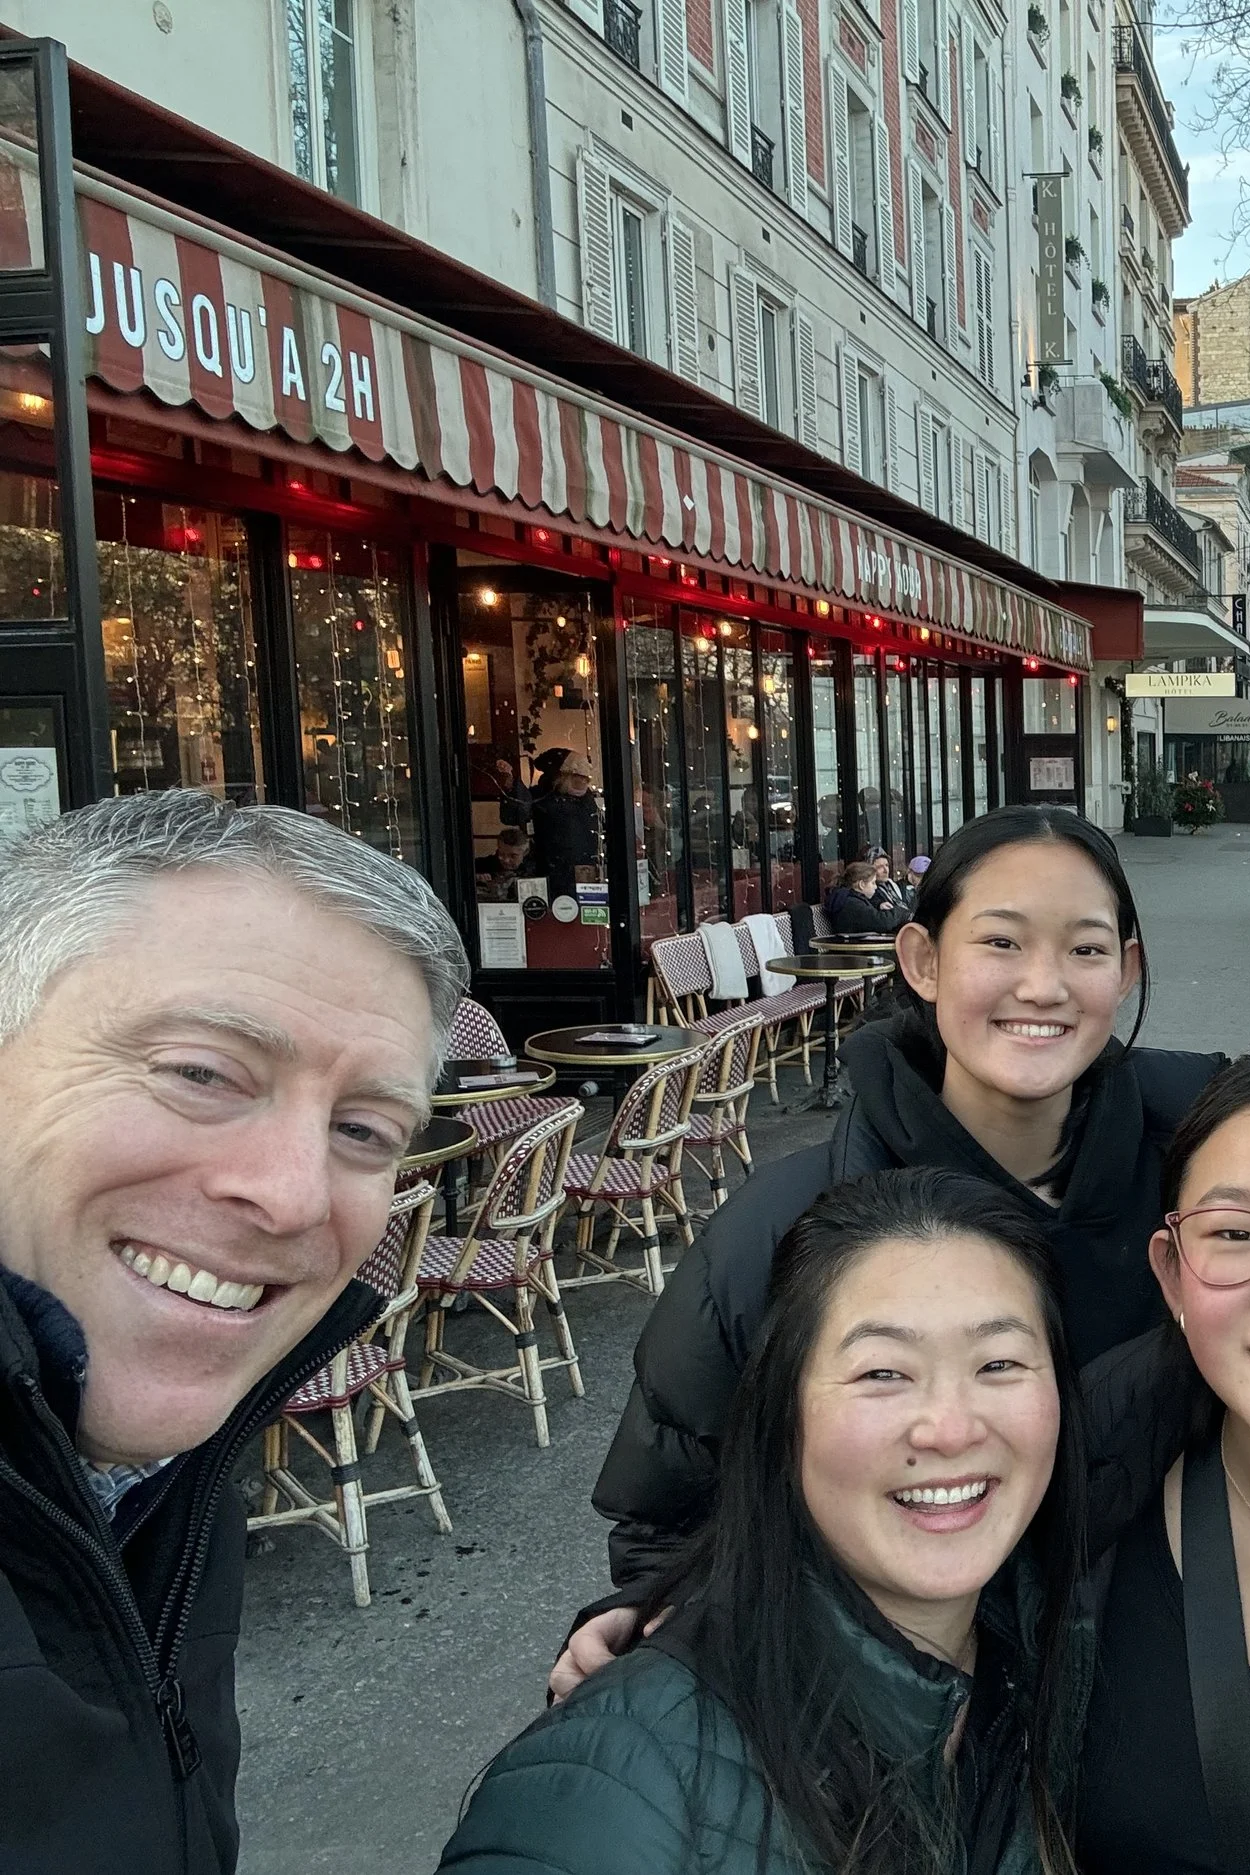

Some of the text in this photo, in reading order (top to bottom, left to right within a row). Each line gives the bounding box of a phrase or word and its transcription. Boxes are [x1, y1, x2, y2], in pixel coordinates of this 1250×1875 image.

[1044, 222, 1057, 316] HÔTEL
[320, 341, 375, 422] 2H
[857, 544, 922, 601] HAPPY HOUR
[1148, 675, 1212, 687] LAMPIKA
